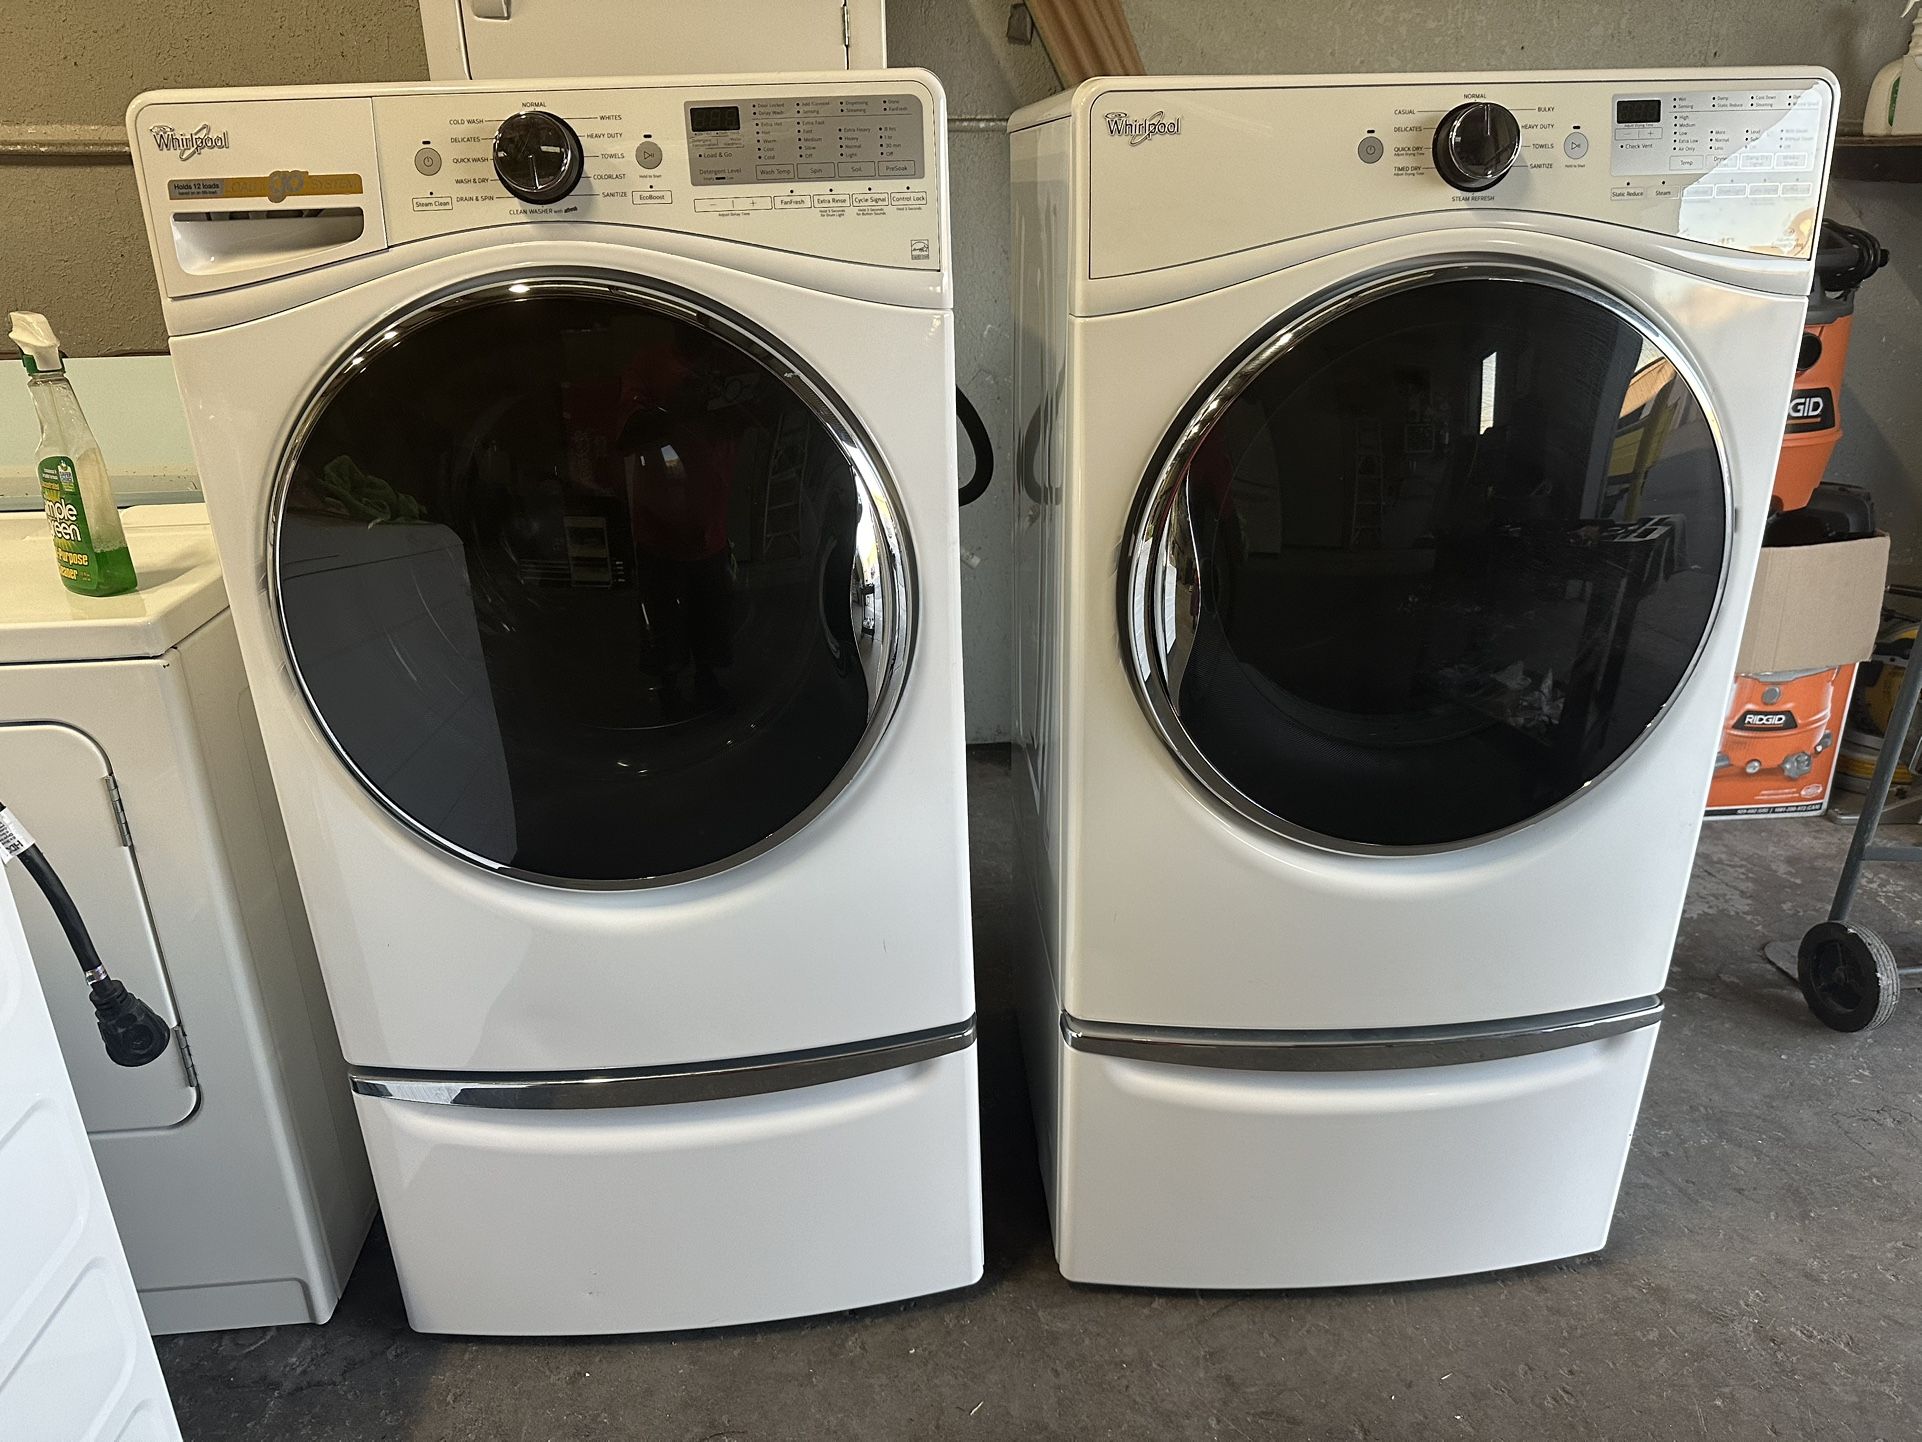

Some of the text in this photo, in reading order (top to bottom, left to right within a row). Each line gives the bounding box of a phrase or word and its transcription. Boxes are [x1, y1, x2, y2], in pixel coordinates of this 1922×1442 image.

[1107, 117, 1180, 140] Whirlpool
[153, 129, 229, 155] Whirlpool
[809, 167, 823, 175] Spin
[433, 200, 450, 208] Clean
[854, 196, 887, 205] Cycle Signal
[1789, 397, 1824, 417] GID
[1744, 714, 1785, 725] RIDGID
